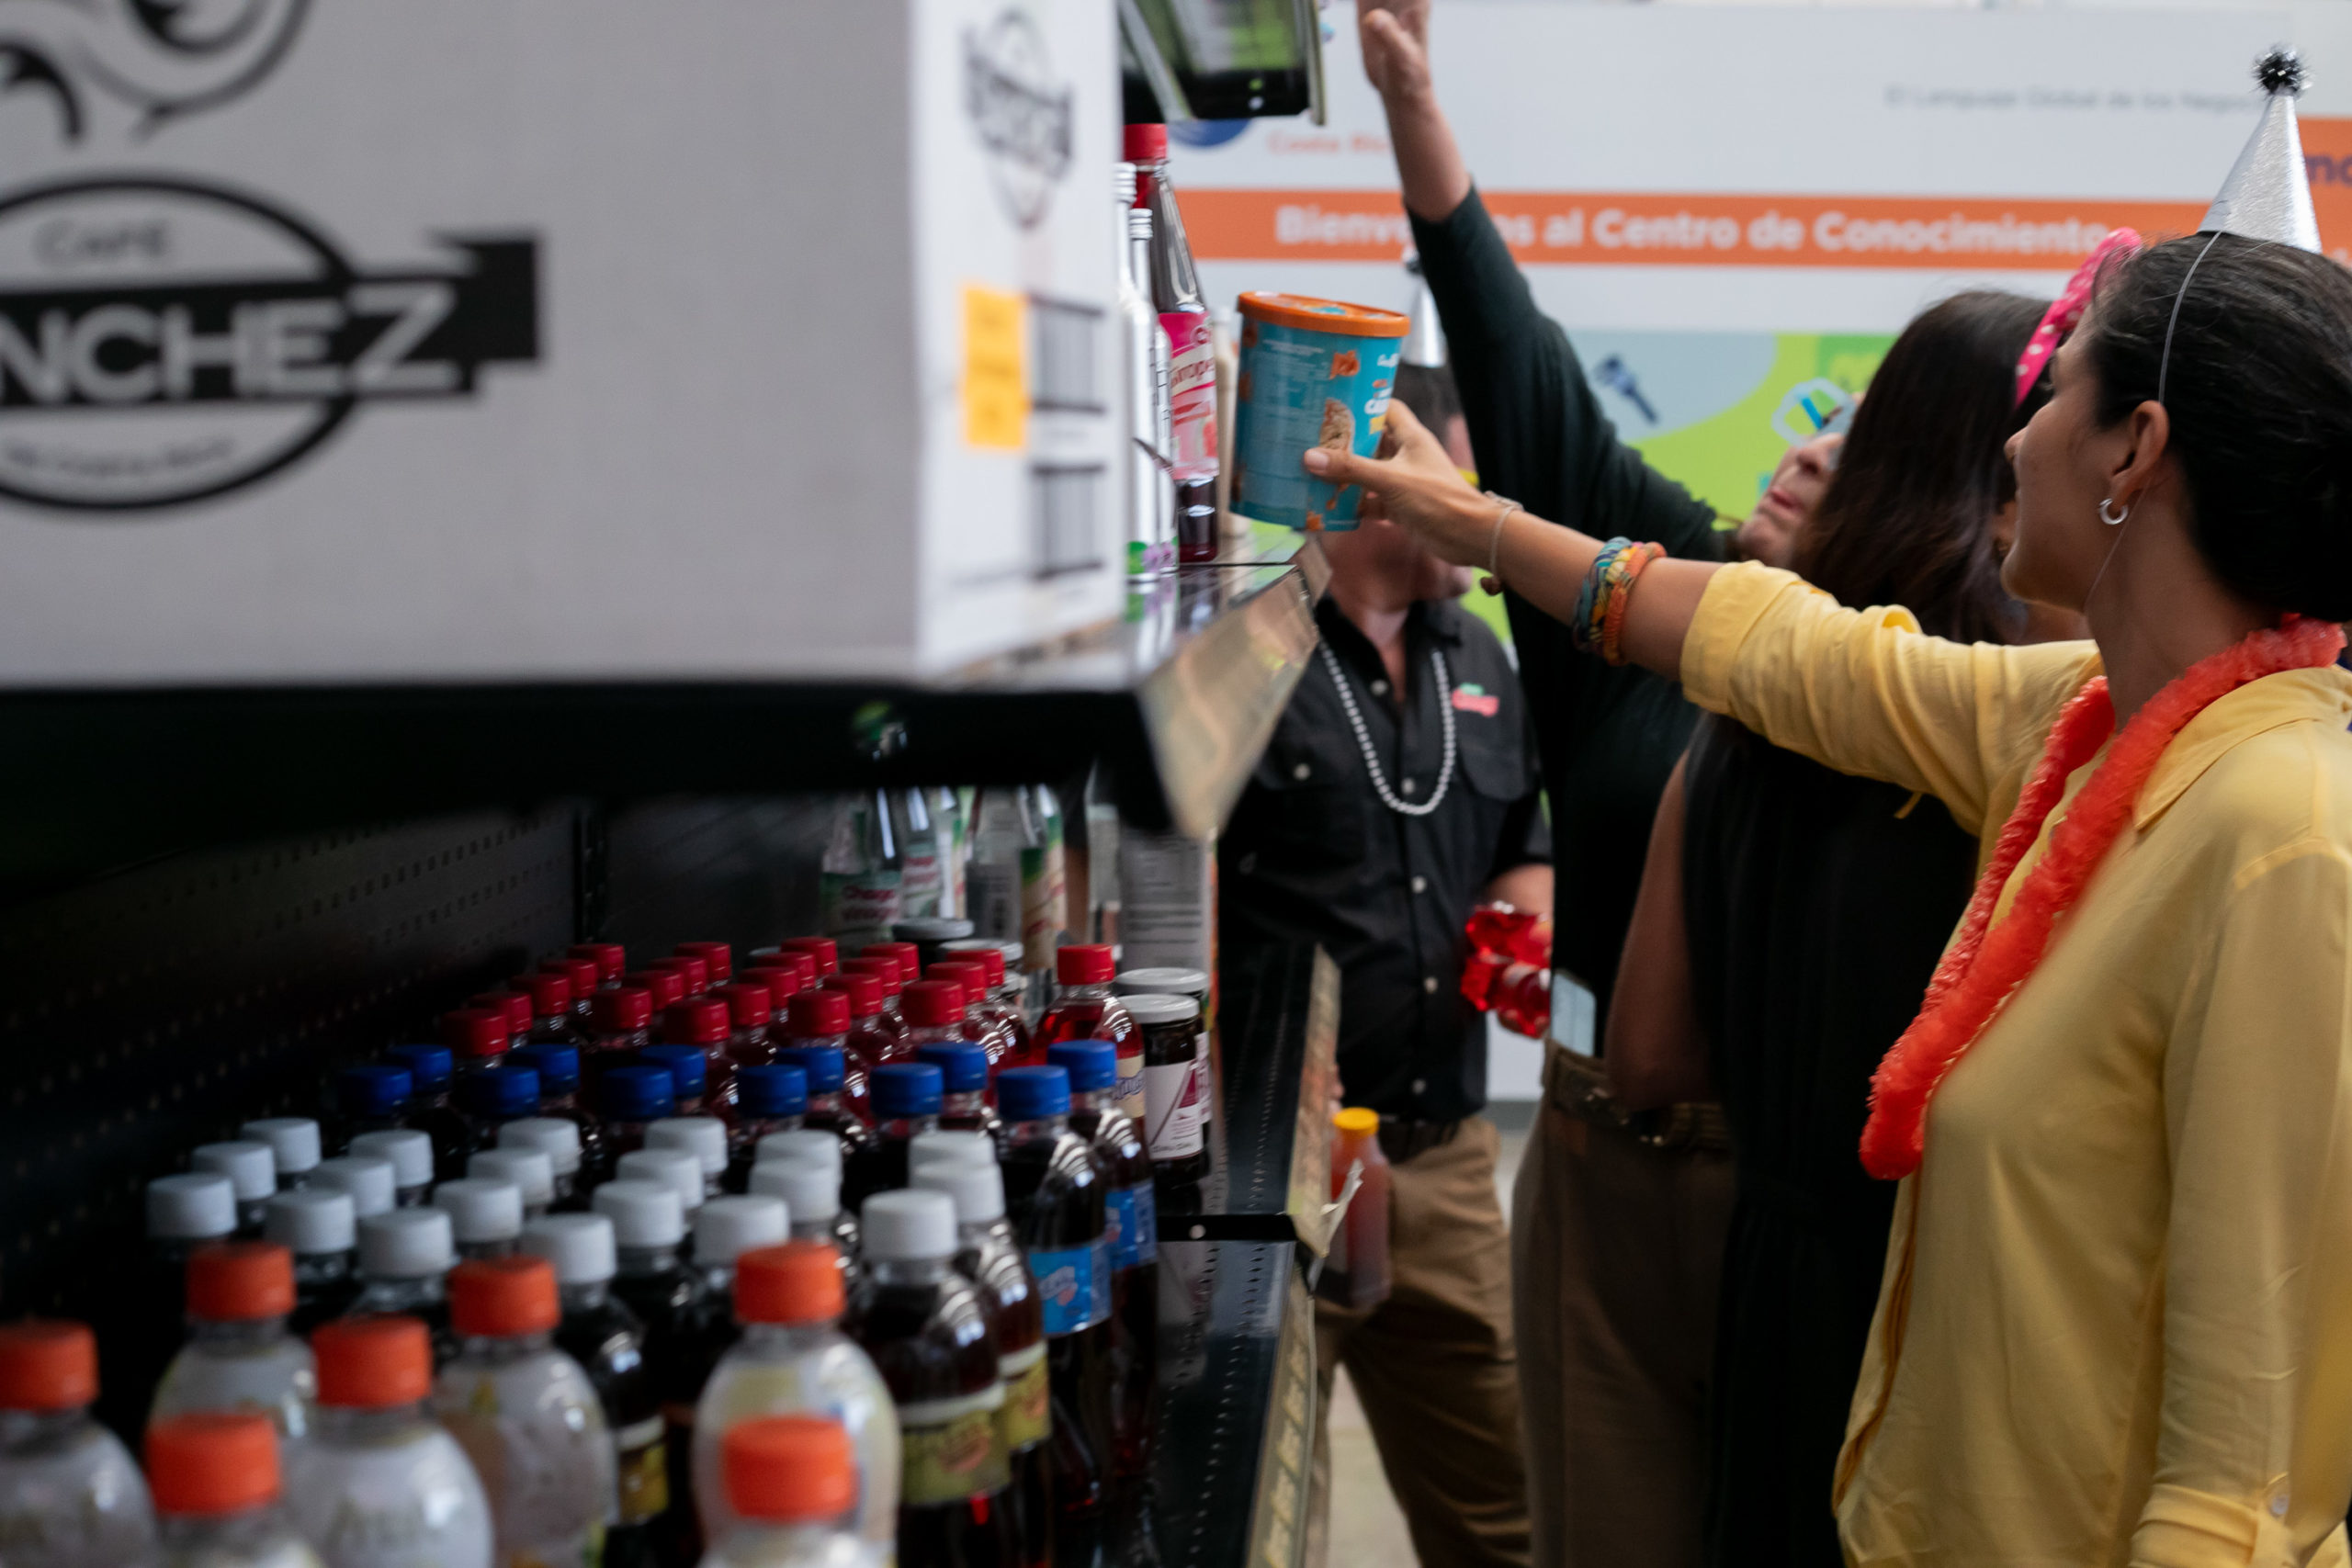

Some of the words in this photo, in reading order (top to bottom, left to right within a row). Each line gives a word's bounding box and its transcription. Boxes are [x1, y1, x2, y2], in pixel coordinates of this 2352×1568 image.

[1543, 208, 1584, 247] al
[1592, 210, 1740, 250] Centro
[1749, 212, 1804, 252] de
[1814, 212, 2110, 254] Conocimiento
